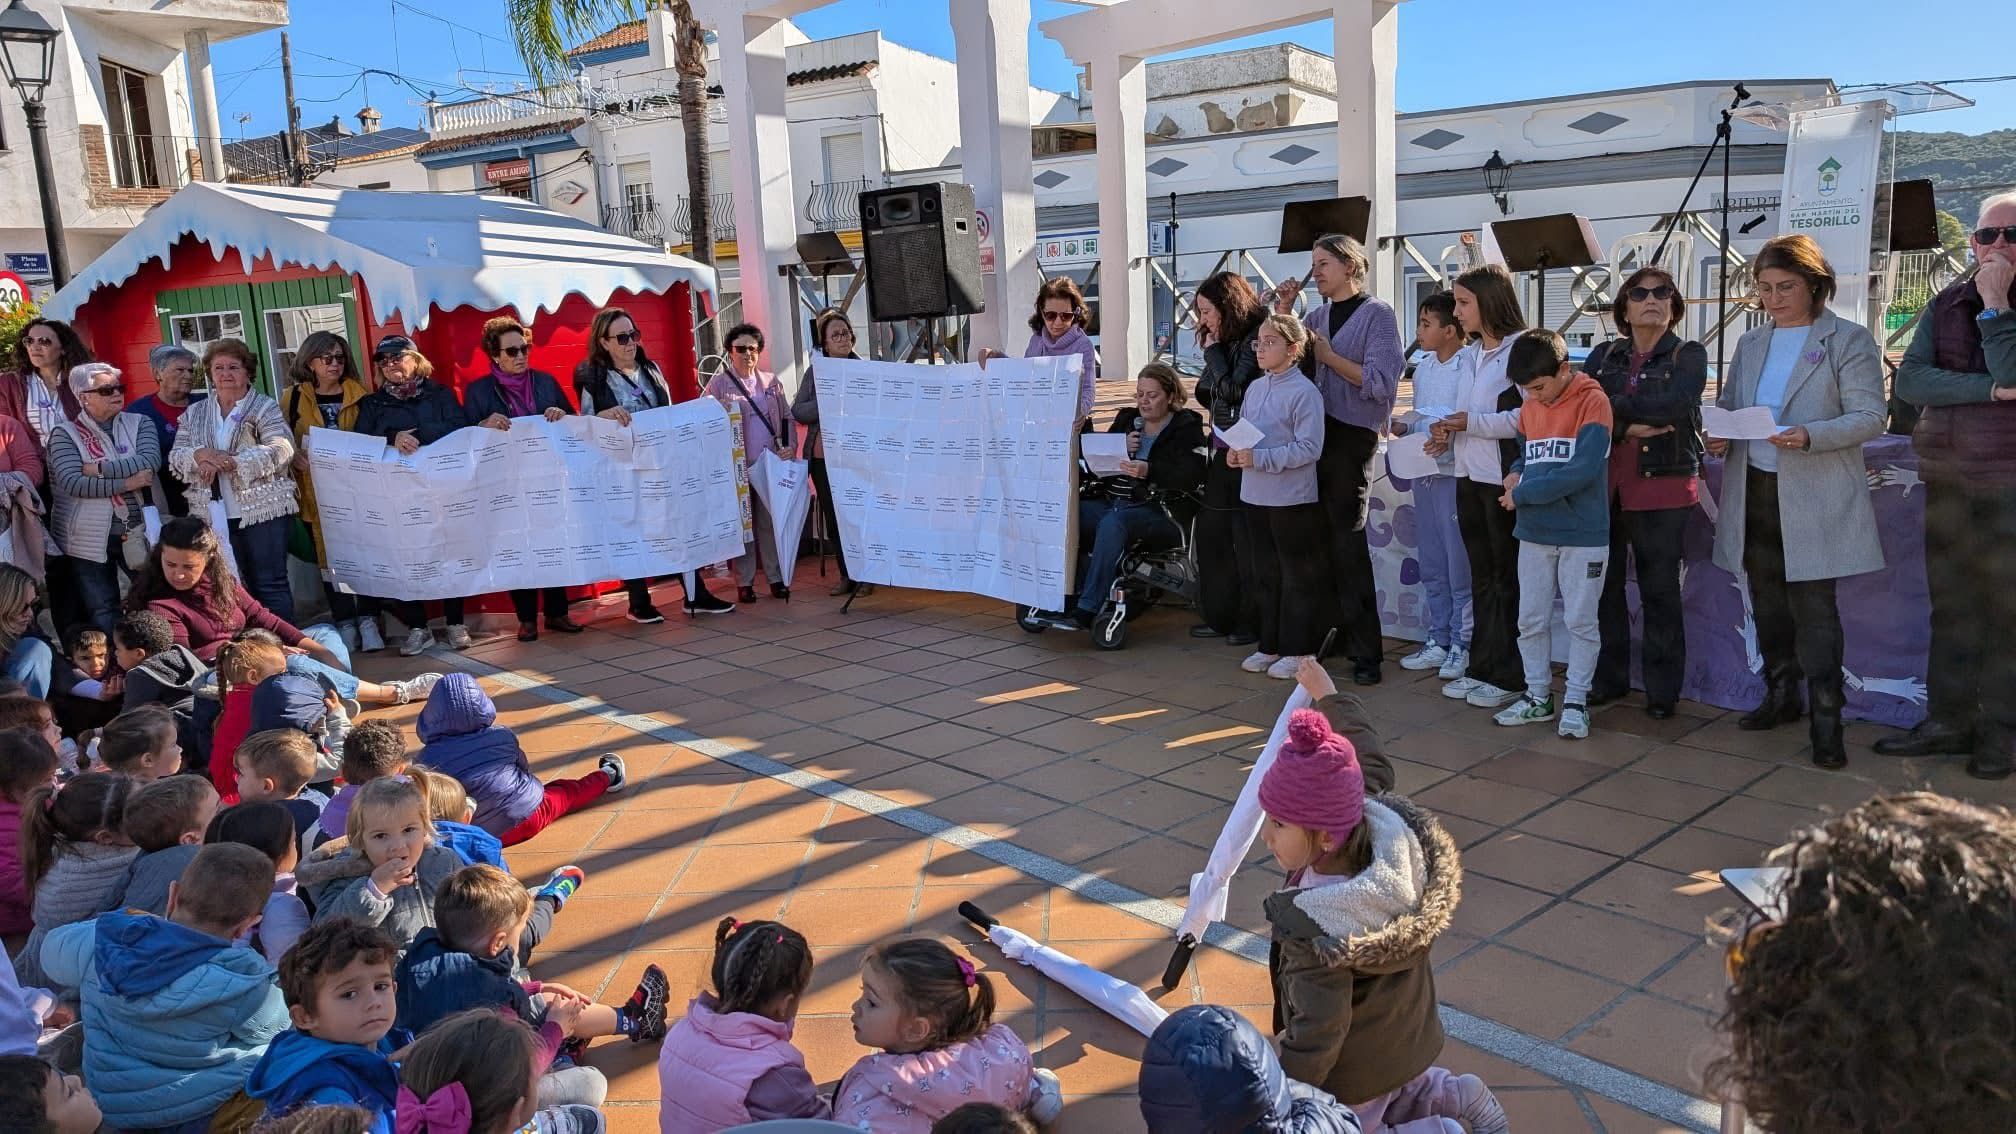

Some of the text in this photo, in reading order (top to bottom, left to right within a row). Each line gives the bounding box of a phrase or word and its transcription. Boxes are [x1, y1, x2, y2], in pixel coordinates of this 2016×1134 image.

[487, 166, 530, 179] ENTRE AMIGO
[1712, 196, 1777, 213] ABIERT
[1789, 214, 1861, 229] TESORILLO
[0, 287, 20, 304] 20
